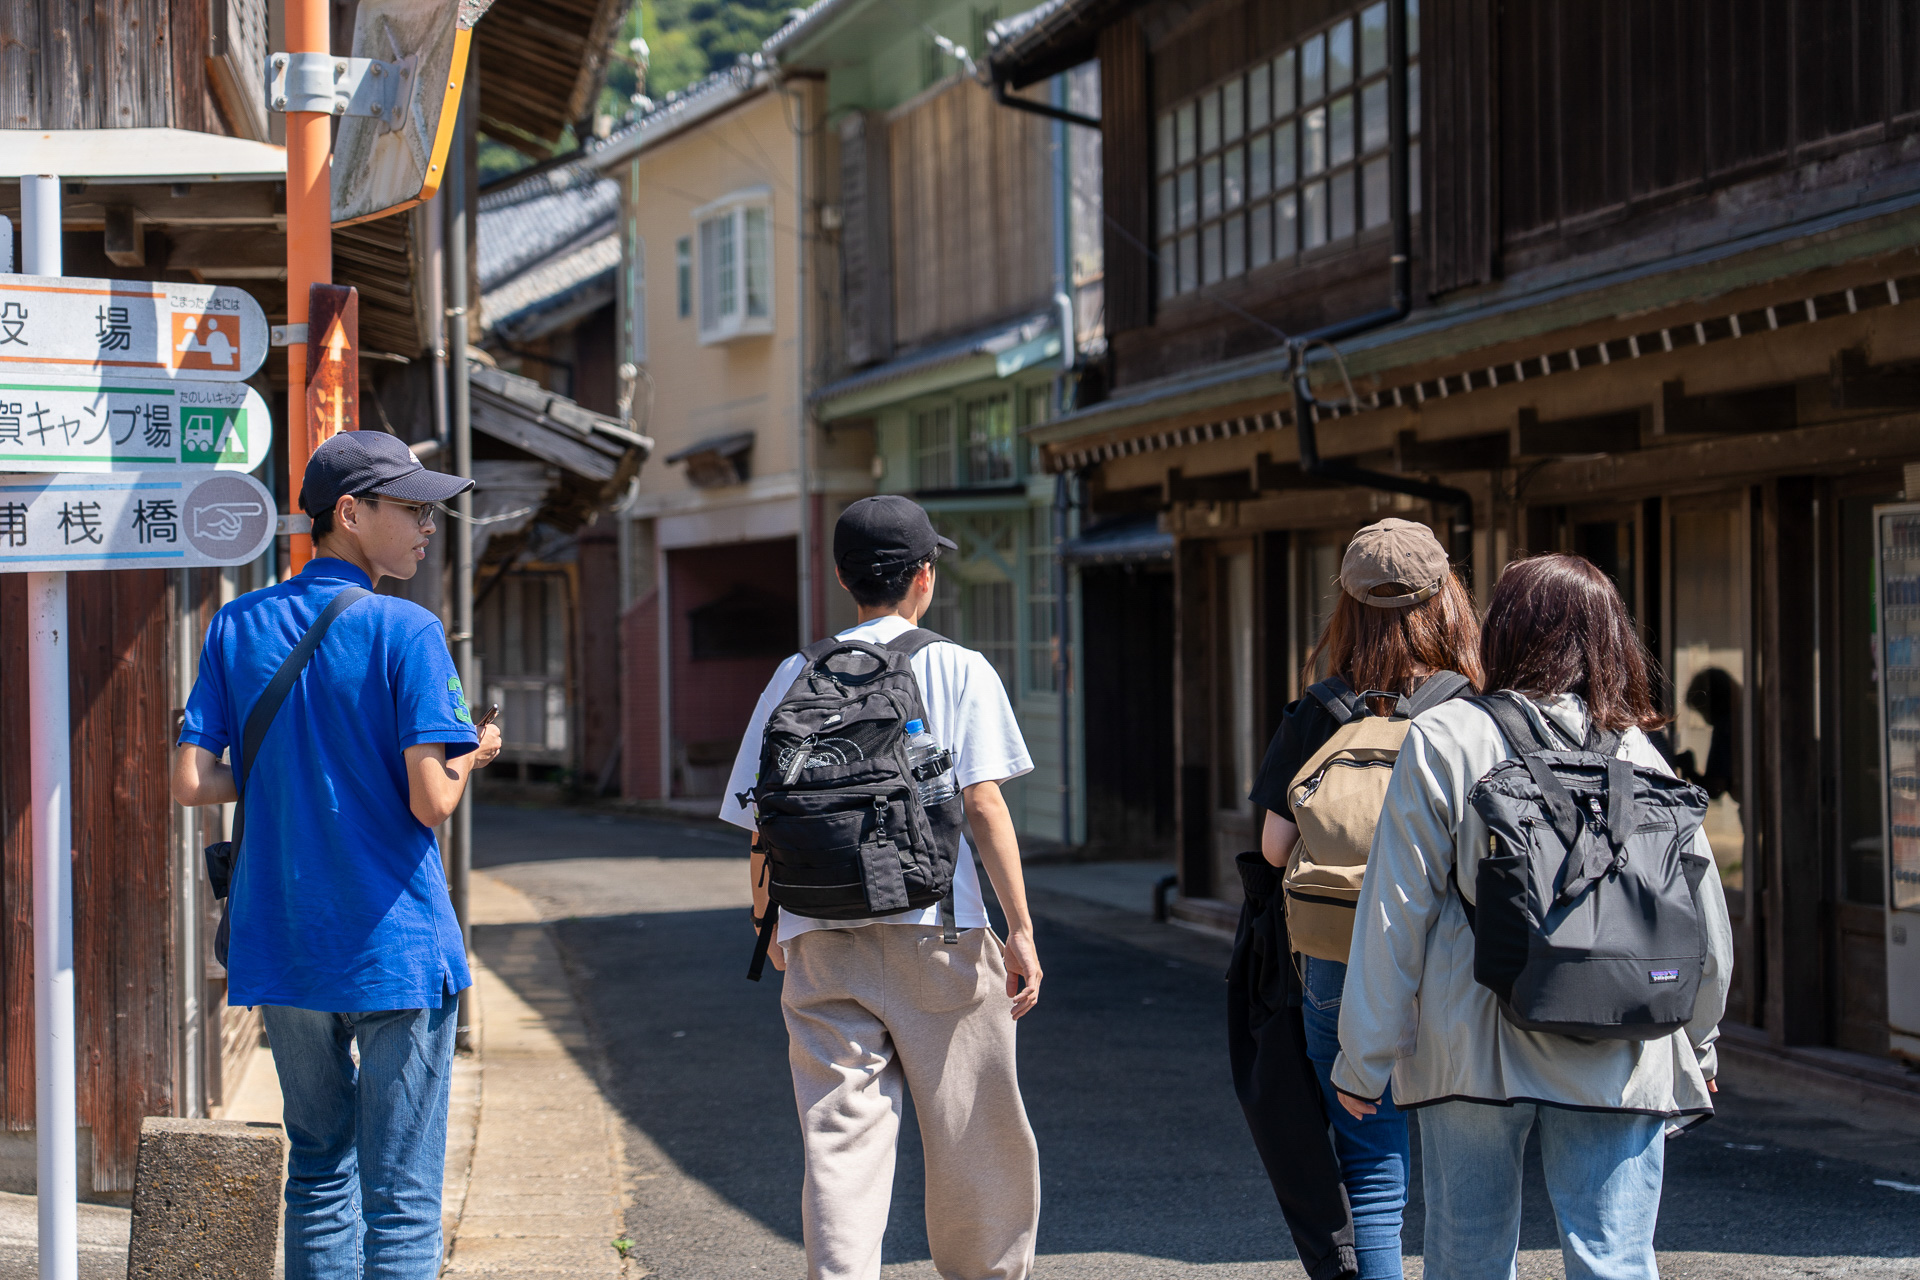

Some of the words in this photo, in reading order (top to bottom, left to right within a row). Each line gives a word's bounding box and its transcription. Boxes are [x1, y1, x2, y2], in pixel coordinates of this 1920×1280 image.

[170, 295, 241, 311] こまったときには
